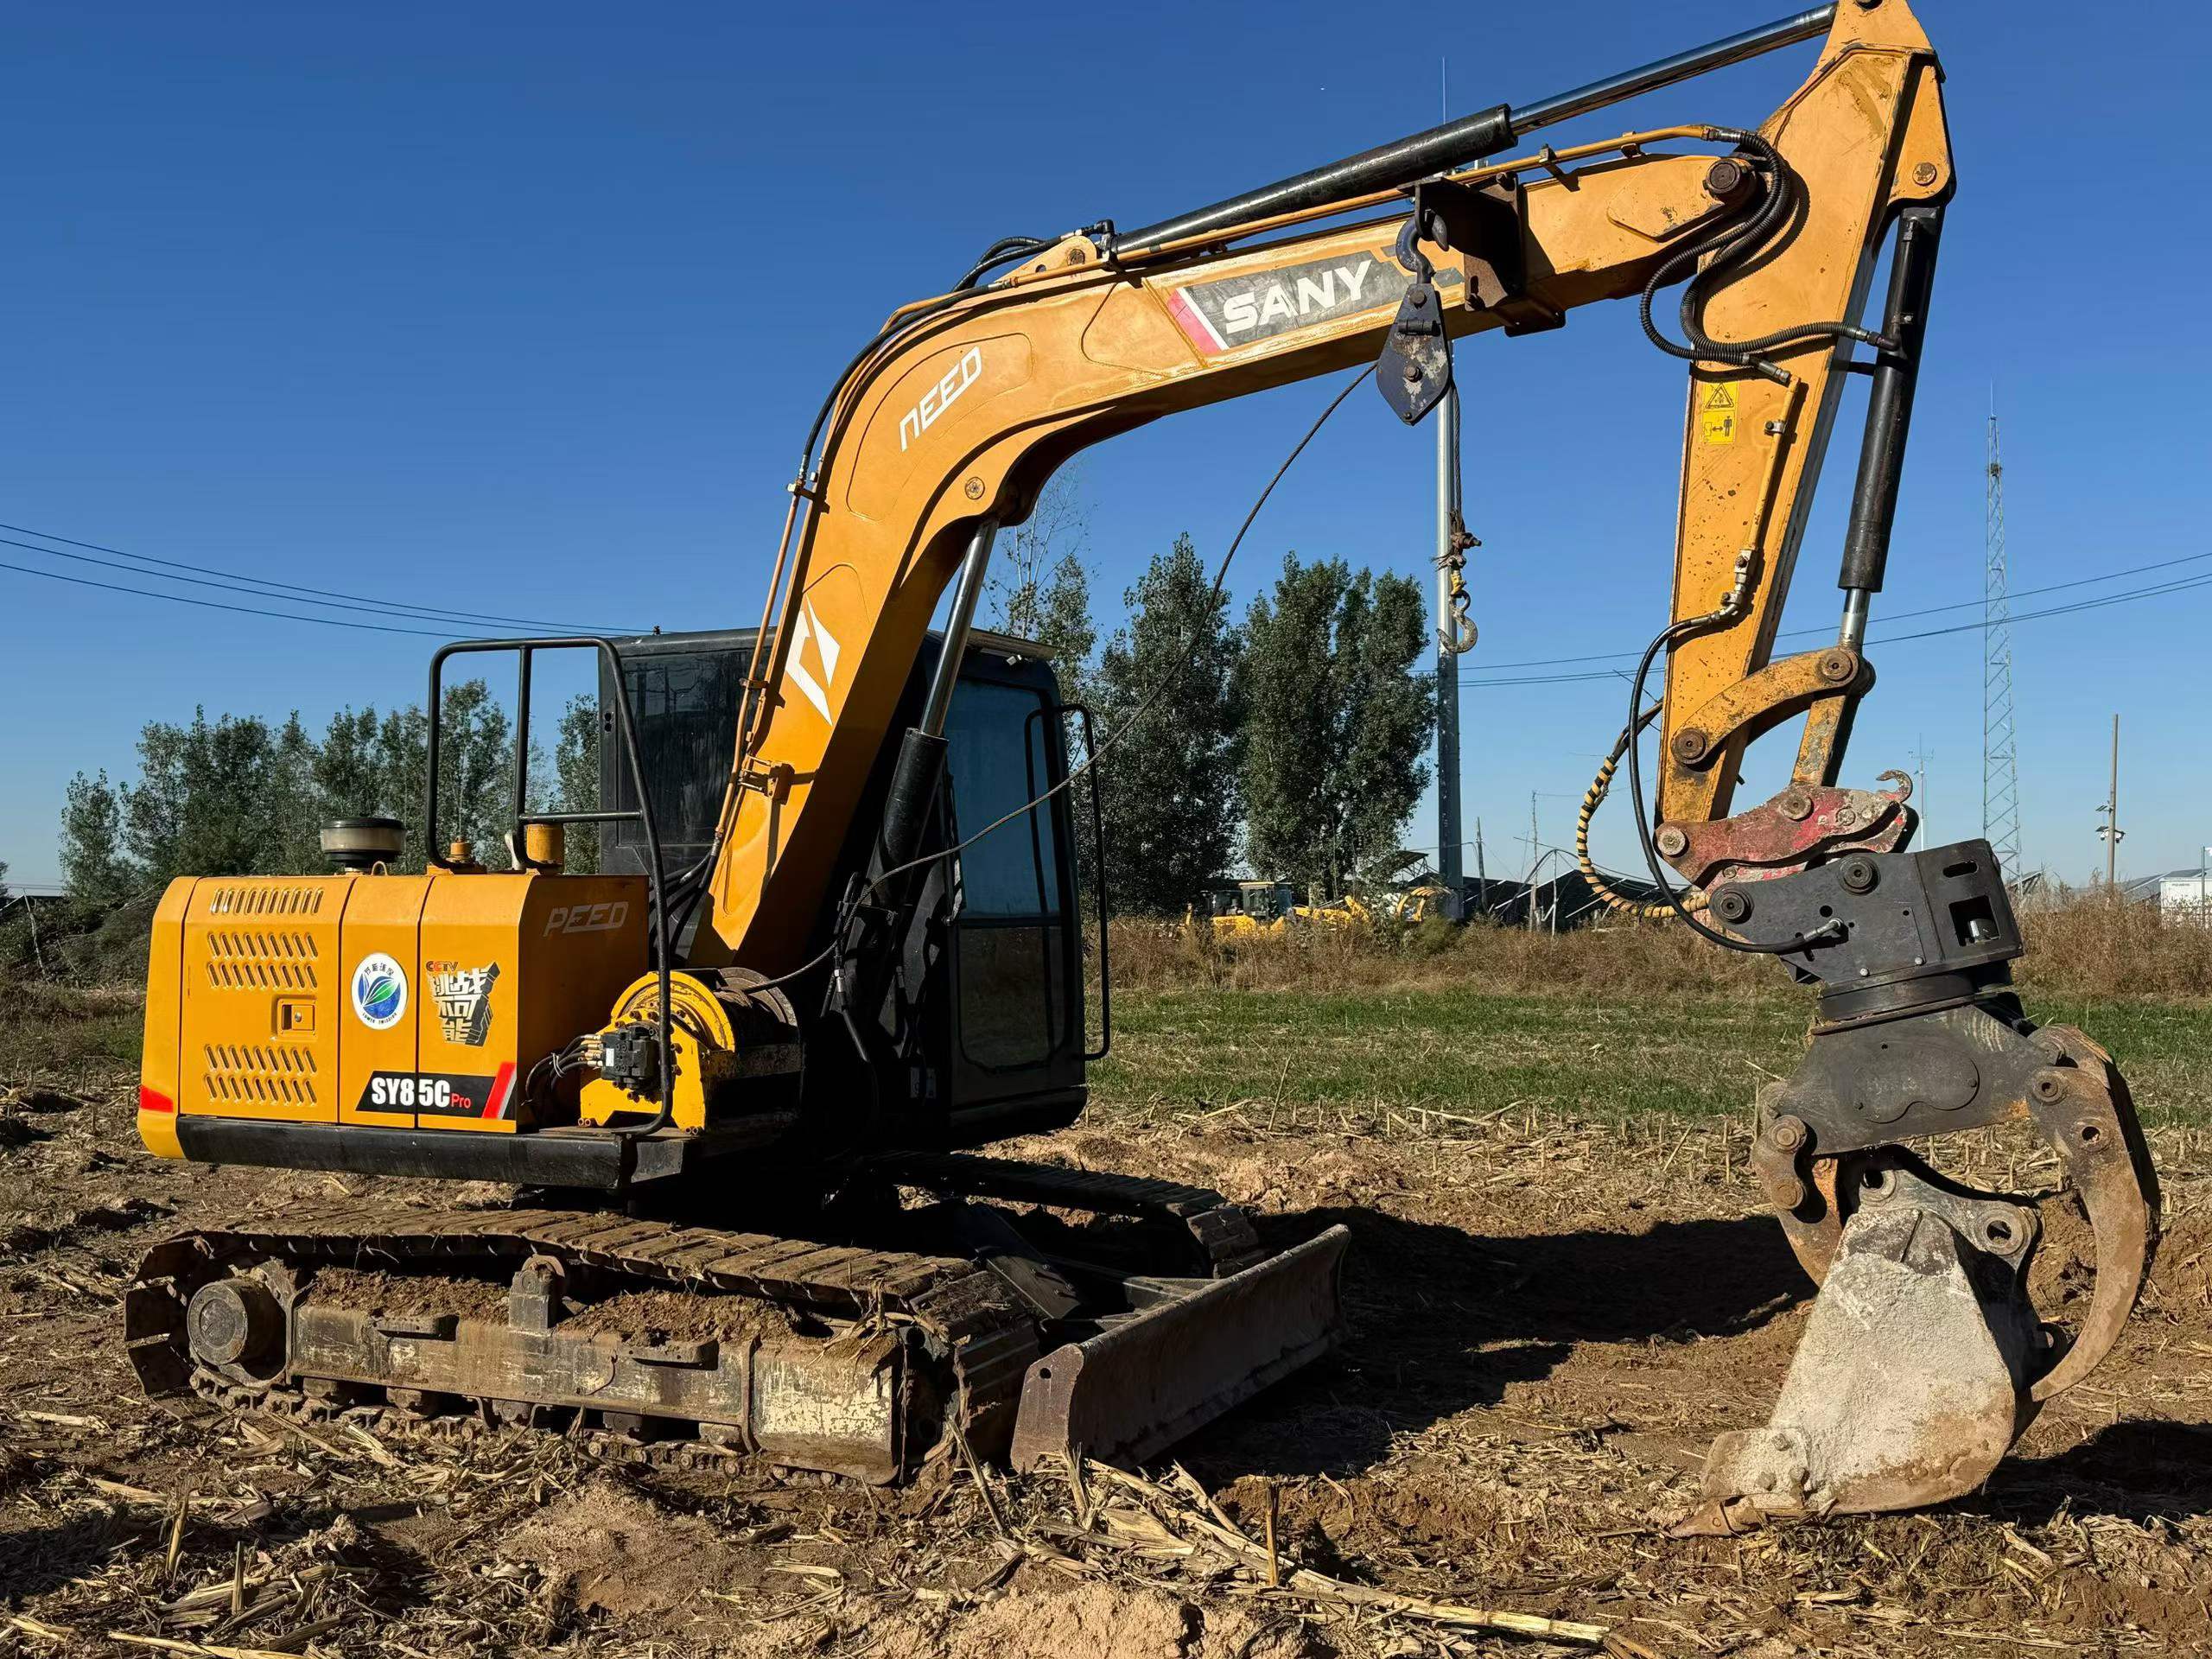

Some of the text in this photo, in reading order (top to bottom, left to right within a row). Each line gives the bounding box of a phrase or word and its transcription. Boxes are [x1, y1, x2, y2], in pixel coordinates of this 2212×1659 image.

[1224, 259, 1372, 335] SANY
[426, 961, 458, 971] CCTV
[429, 967, 489, 996] 挑战
[372, 1077, 472, 1109] SY85C Pro
